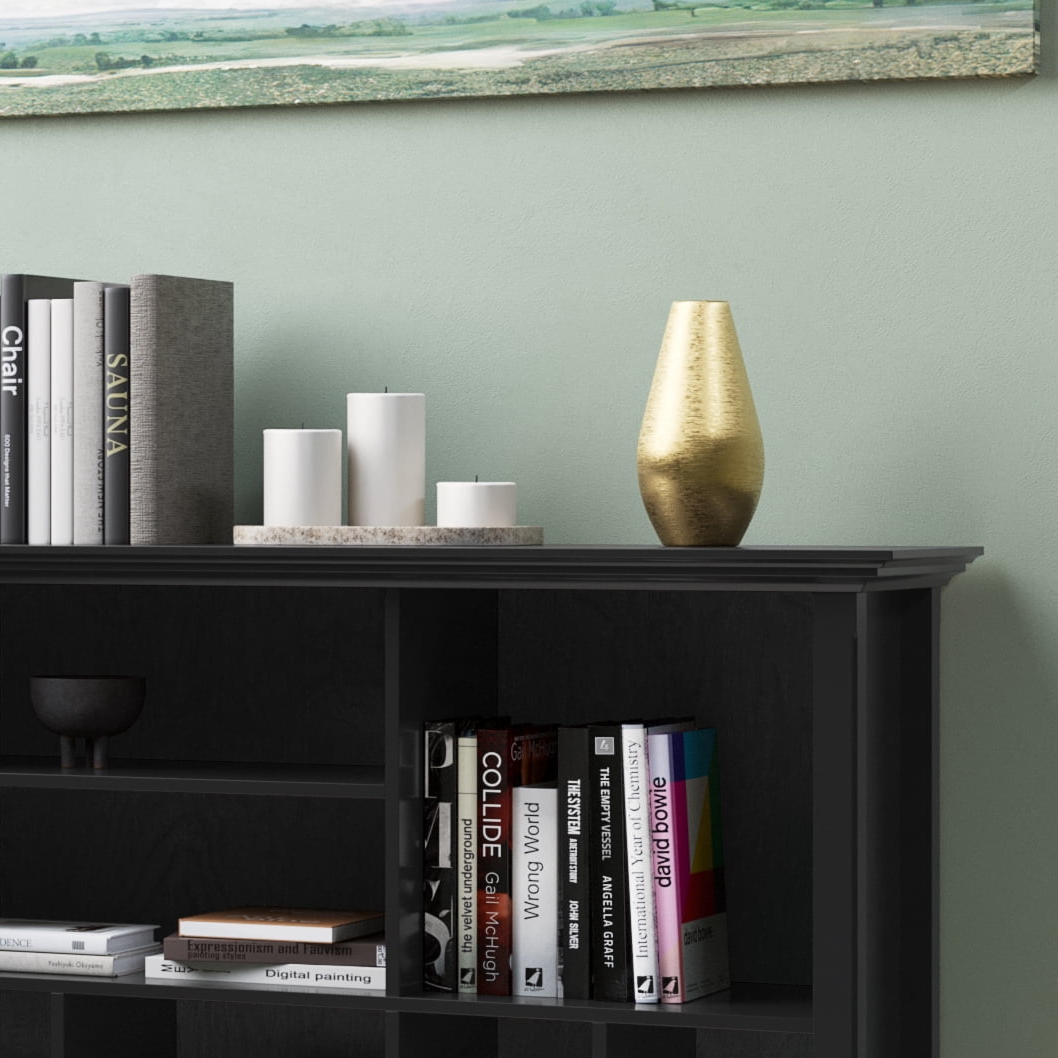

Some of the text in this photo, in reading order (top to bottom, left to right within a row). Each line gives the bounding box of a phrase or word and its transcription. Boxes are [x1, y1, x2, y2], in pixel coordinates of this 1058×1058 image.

[2, 325, 23, 396] Chair
[106, 353, 128, 457] SAUNA
[461, 818, 474, 953] the velvet underground
[482, 752, 502, 982] COLLIDE Gail McHugh
[524, 802, 544, 920] Wrong World
[600, 766, 614, 968] THE EMPTY VESSEL ANGELLA GRAFF
[628, 740, 648, 958] International Year of Chemistry
[649, 777, 672, 888] david bowie
[187, 940, 352, 957] Expressionism and Fauvism
[187, 950, 246, 961] painting styles
[265, 968, 372, 985] Digital painting
[568, 900, 579, 949] JOHN SILVER
